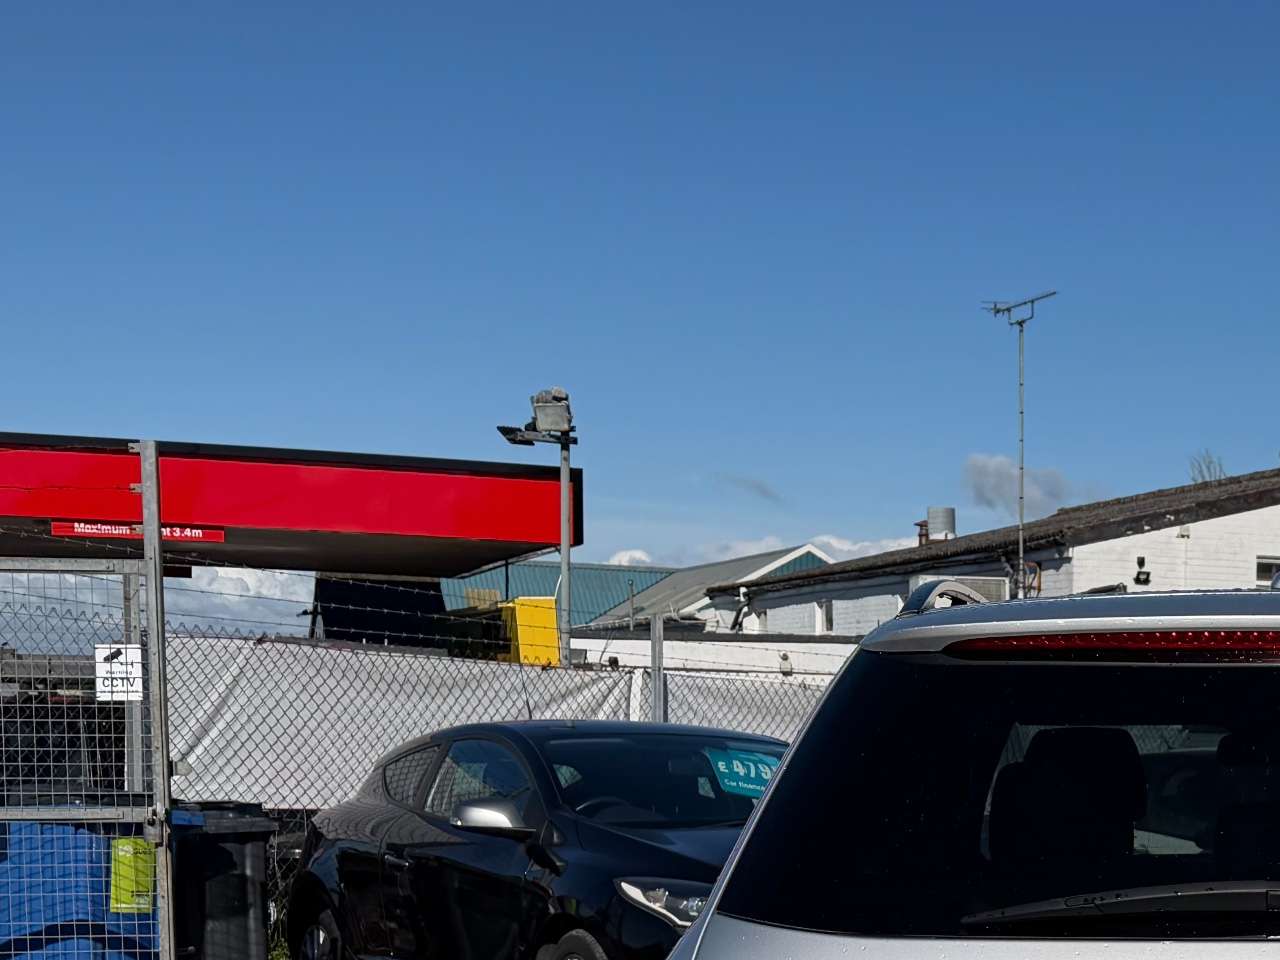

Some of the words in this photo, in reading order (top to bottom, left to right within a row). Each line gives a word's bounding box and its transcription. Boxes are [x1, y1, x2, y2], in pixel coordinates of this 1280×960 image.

[73, 522, 131, 534] Maximum
[172, 527, 203, 537] 3.4m
[102, 677, 136, 688] CCTV
